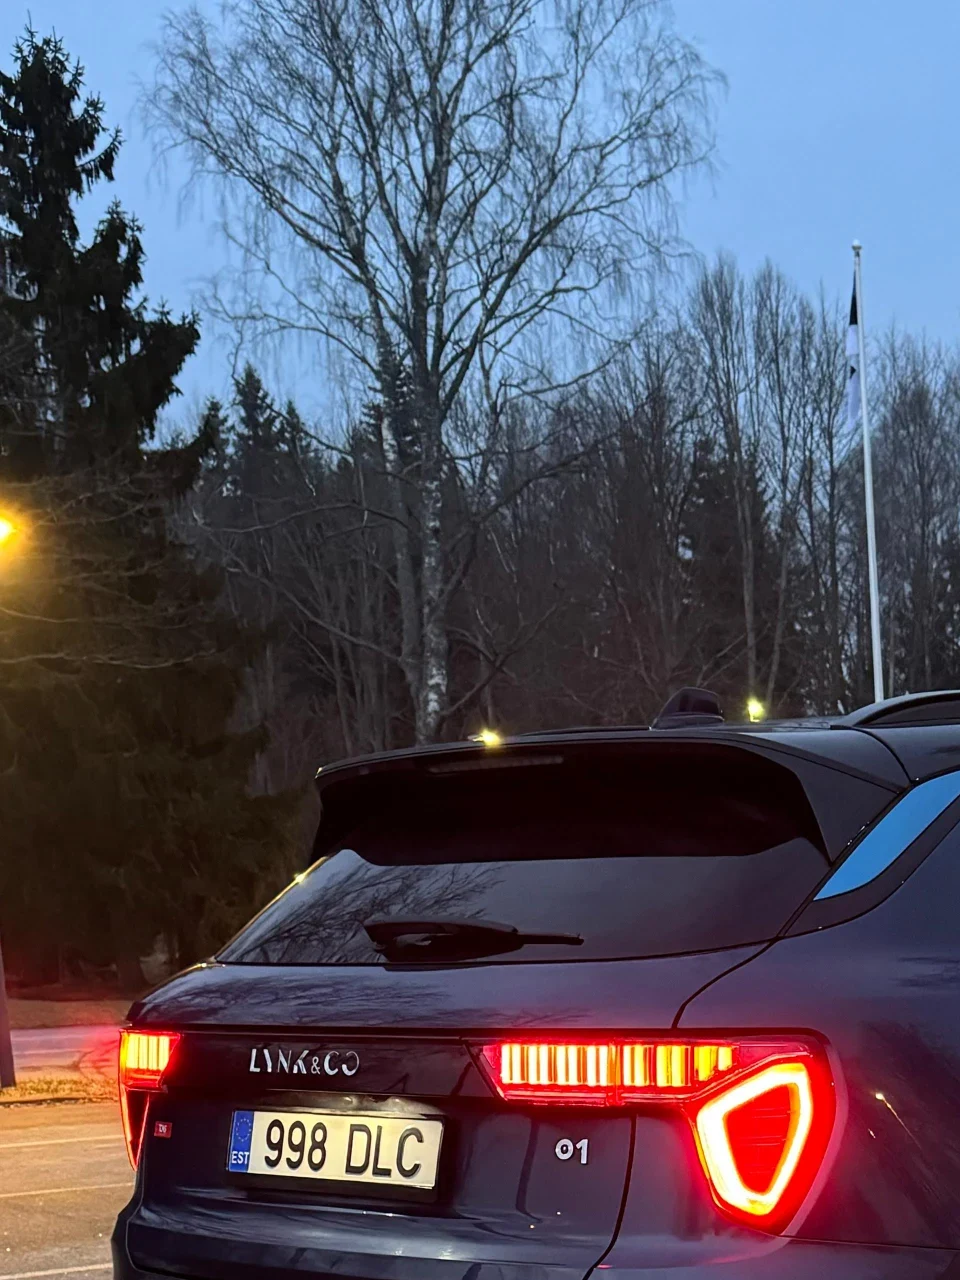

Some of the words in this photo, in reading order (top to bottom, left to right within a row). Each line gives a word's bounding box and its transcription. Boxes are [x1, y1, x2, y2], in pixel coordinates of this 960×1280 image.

[231, 1151, 250, 1165] EST
[264, 1118, 328, 1172] 998
[344, 1123, 425, 1178] DLC
[555, 1138, 589, 1164] 01
